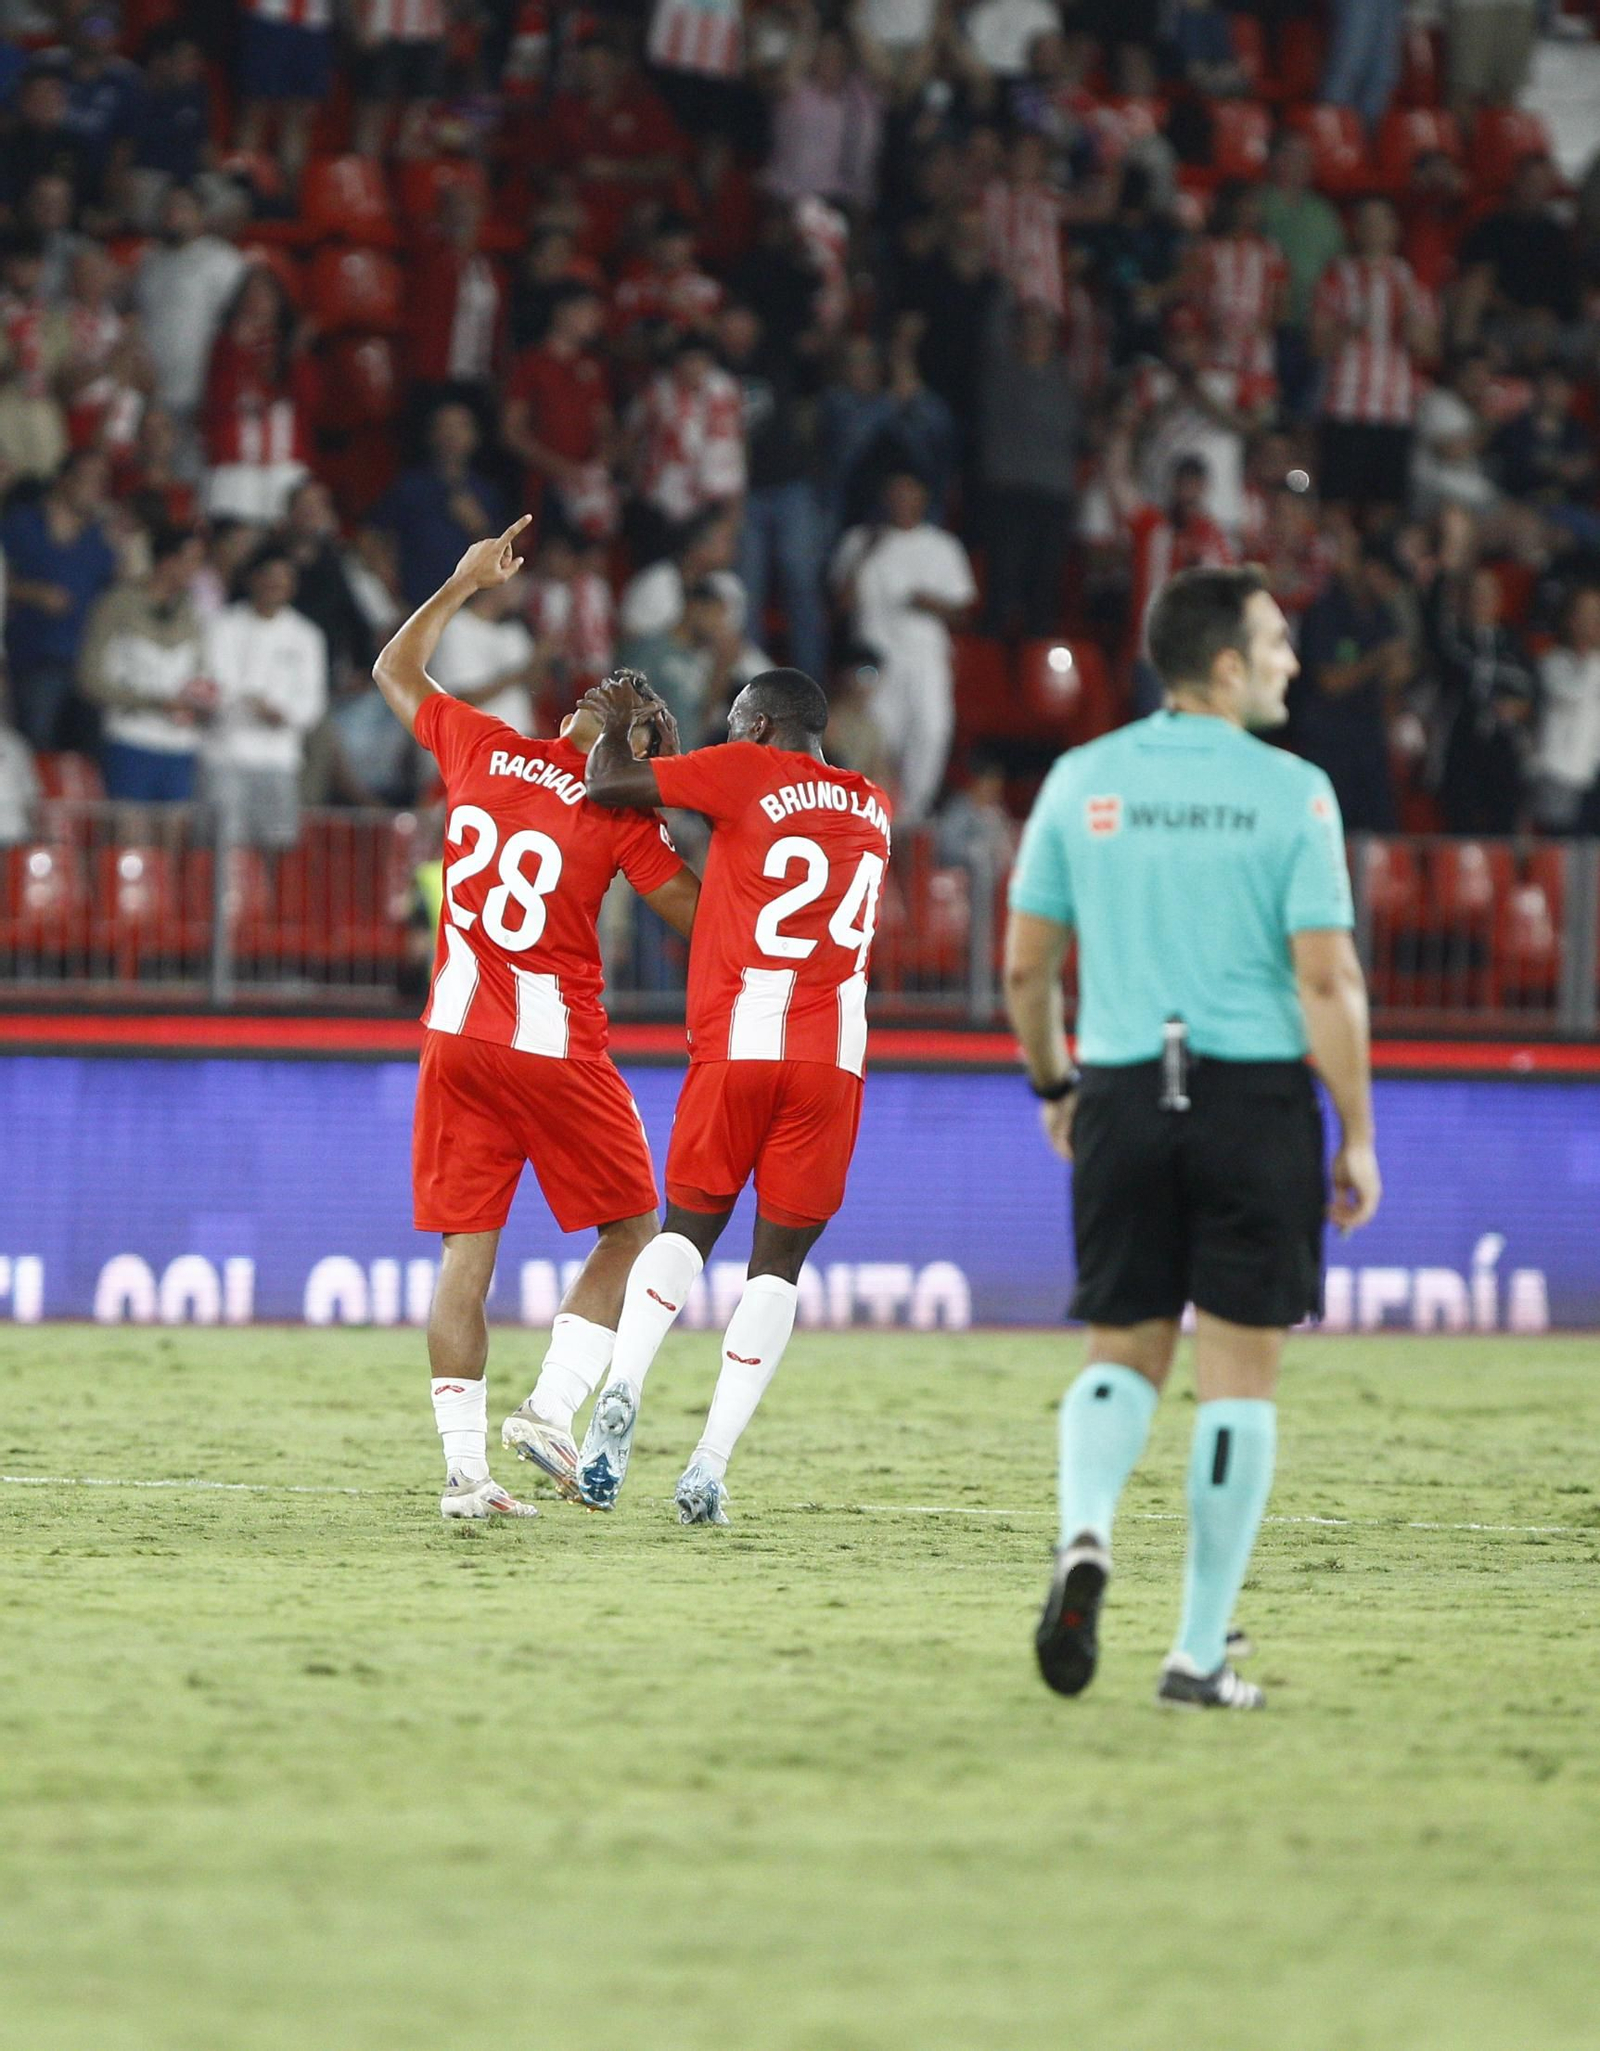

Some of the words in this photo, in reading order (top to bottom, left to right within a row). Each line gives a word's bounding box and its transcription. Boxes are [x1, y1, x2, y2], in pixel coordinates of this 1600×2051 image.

[489, 750, 587, 805] RACHAD
[760, 780, 848, 824] BRUNO
[850, 791, 891, 856] LAN
[446, 804, 563, 953] 28
[754, 835, 884, 973] 24
